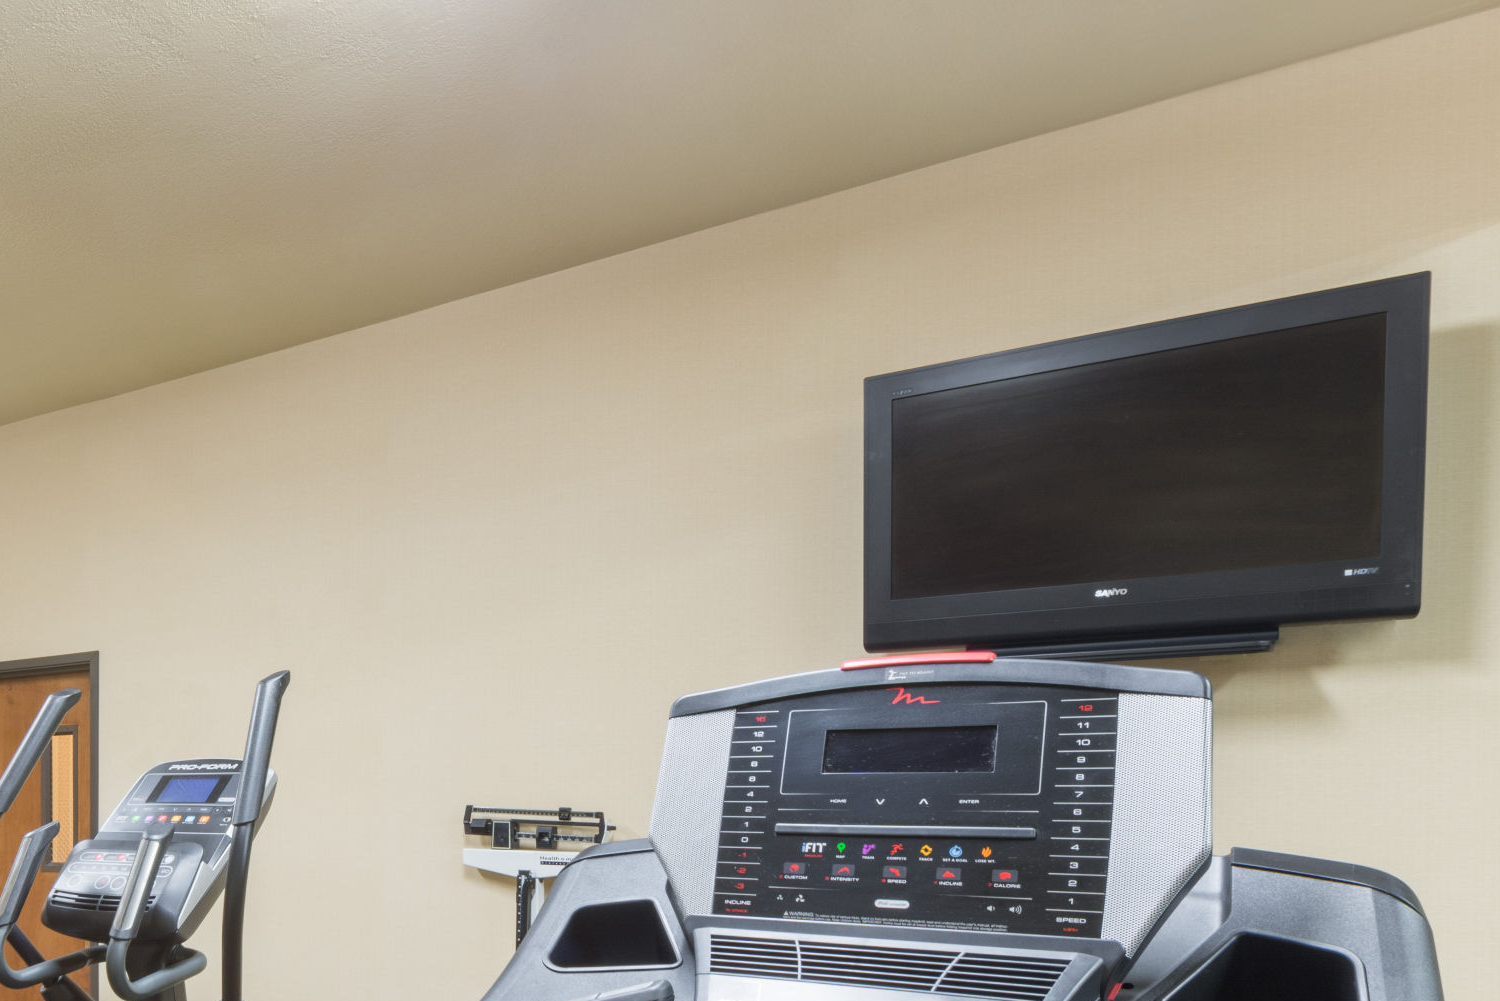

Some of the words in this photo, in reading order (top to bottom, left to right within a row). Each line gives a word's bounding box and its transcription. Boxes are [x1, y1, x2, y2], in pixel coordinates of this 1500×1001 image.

[1094, 587, 1128, 598] SANYO
[1078, 704, 1093, 712] 12
[1076, 721, 1090, 729] 11
[752, 730, 765, 738] 12
[1075, 738, 1091, 746] 10
[750, 745, 763, 753] 10
[168, 763, 239, 771] PRO-FORM
[1075, 773, 1085, 781] 8
[1074, 790, 1084, 798] 7
[1071, 826, 1082, 834] 5
[1070, 843, 1080, 851] 4
[1069, 861, 1079, 869] 3
[1067, 879, 1078, 887] 2
[1067, 897, 1074, 905] 1
[1055, 916, 1087, 924] SPEED
